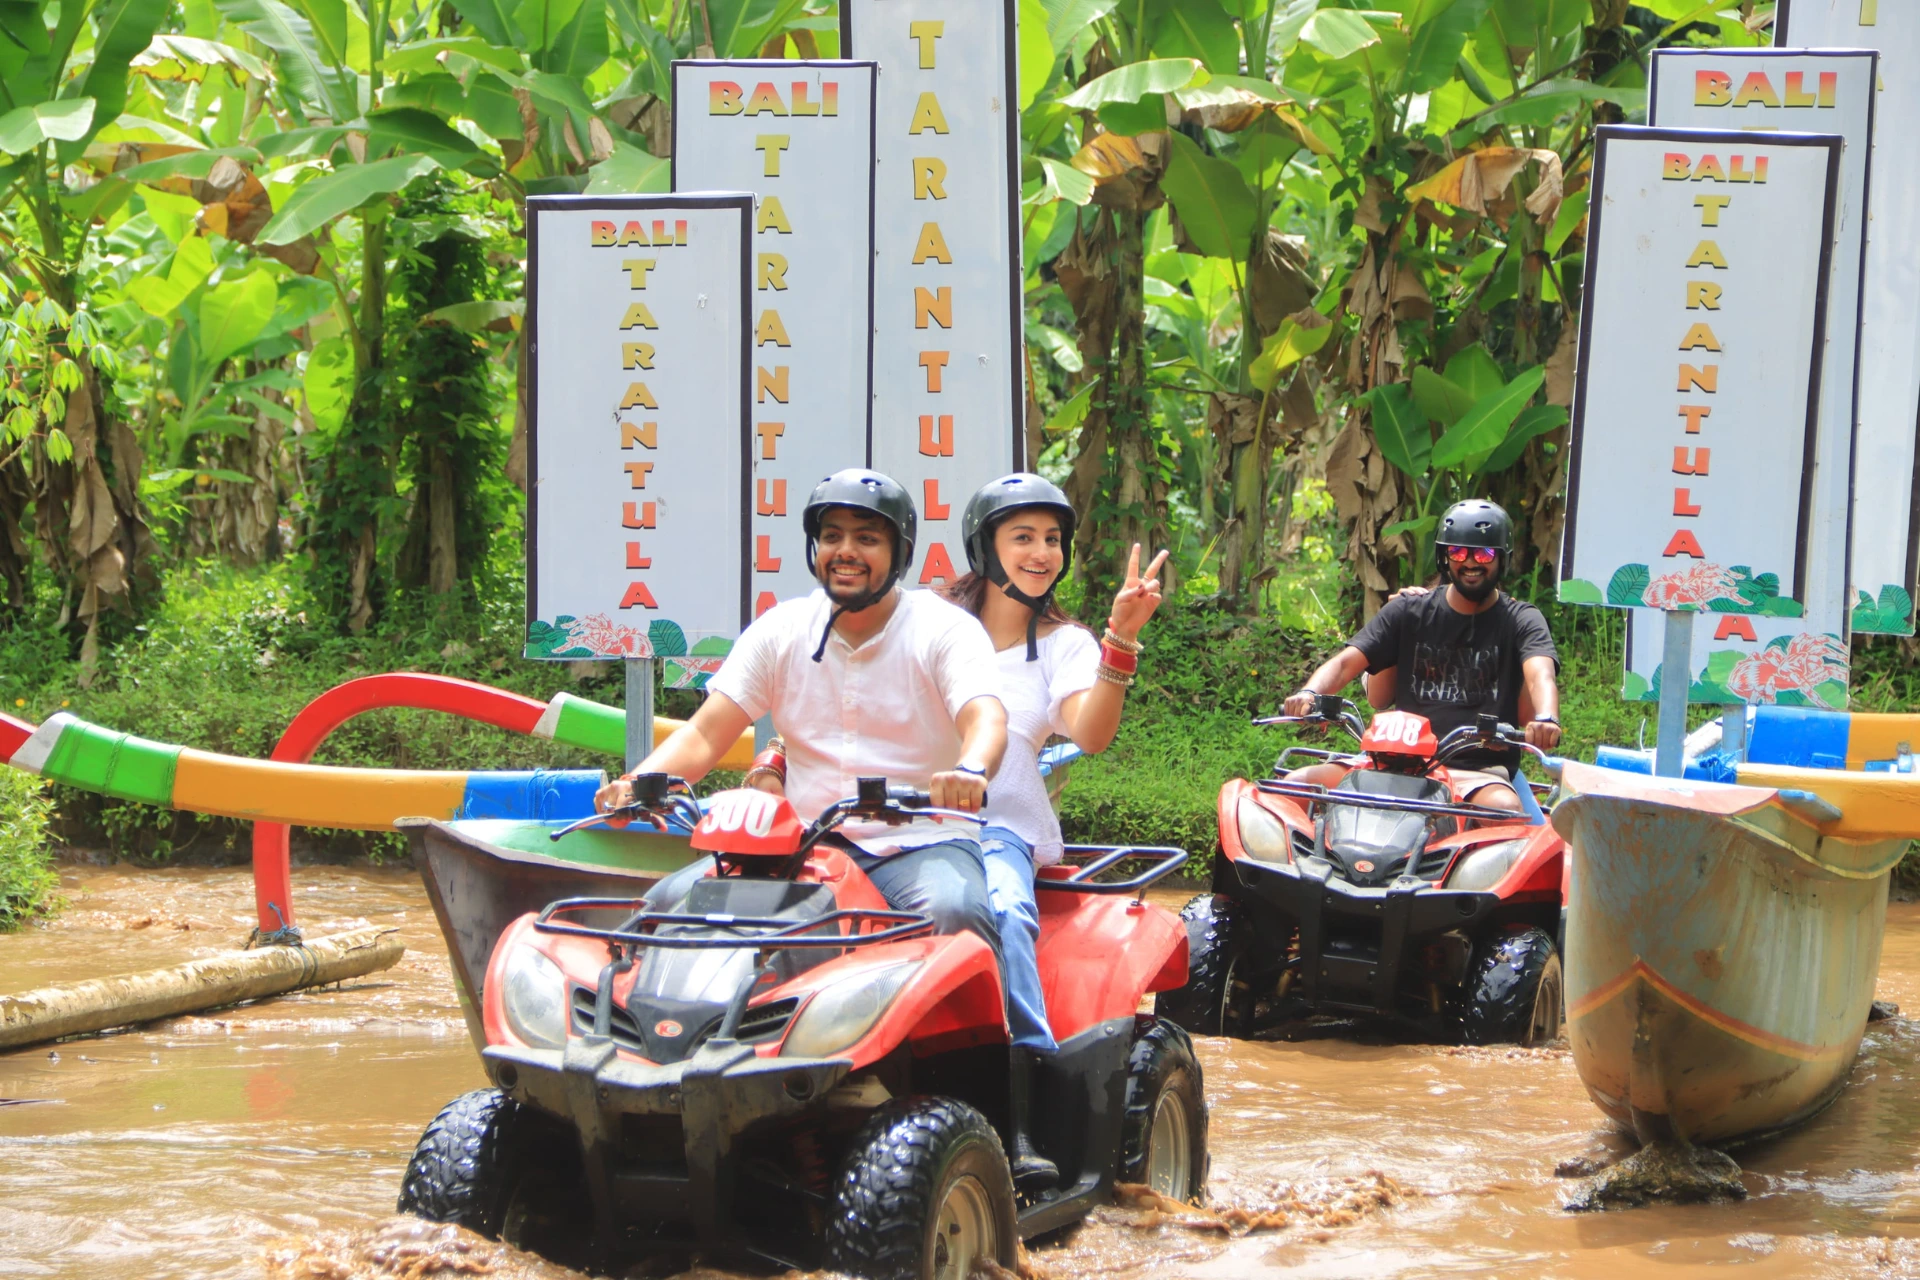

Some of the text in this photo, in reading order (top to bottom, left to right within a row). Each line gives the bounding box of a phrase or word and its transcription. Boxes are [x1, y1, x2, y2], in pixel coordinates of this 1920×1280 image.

[709, 81, 839, 117] BALI
[1694, 70, 1838, 108] BALI
[1662, 152, 1769, 184] BALI
[591, 220, 688, 247] BALI
[909, 20, 957, 585] TARANTULA
[1662, 195, 1732, 559] TARANTULA
[619, 259, 659, 610] TARANTULA
[1372, 714, 1422, 746] 208
